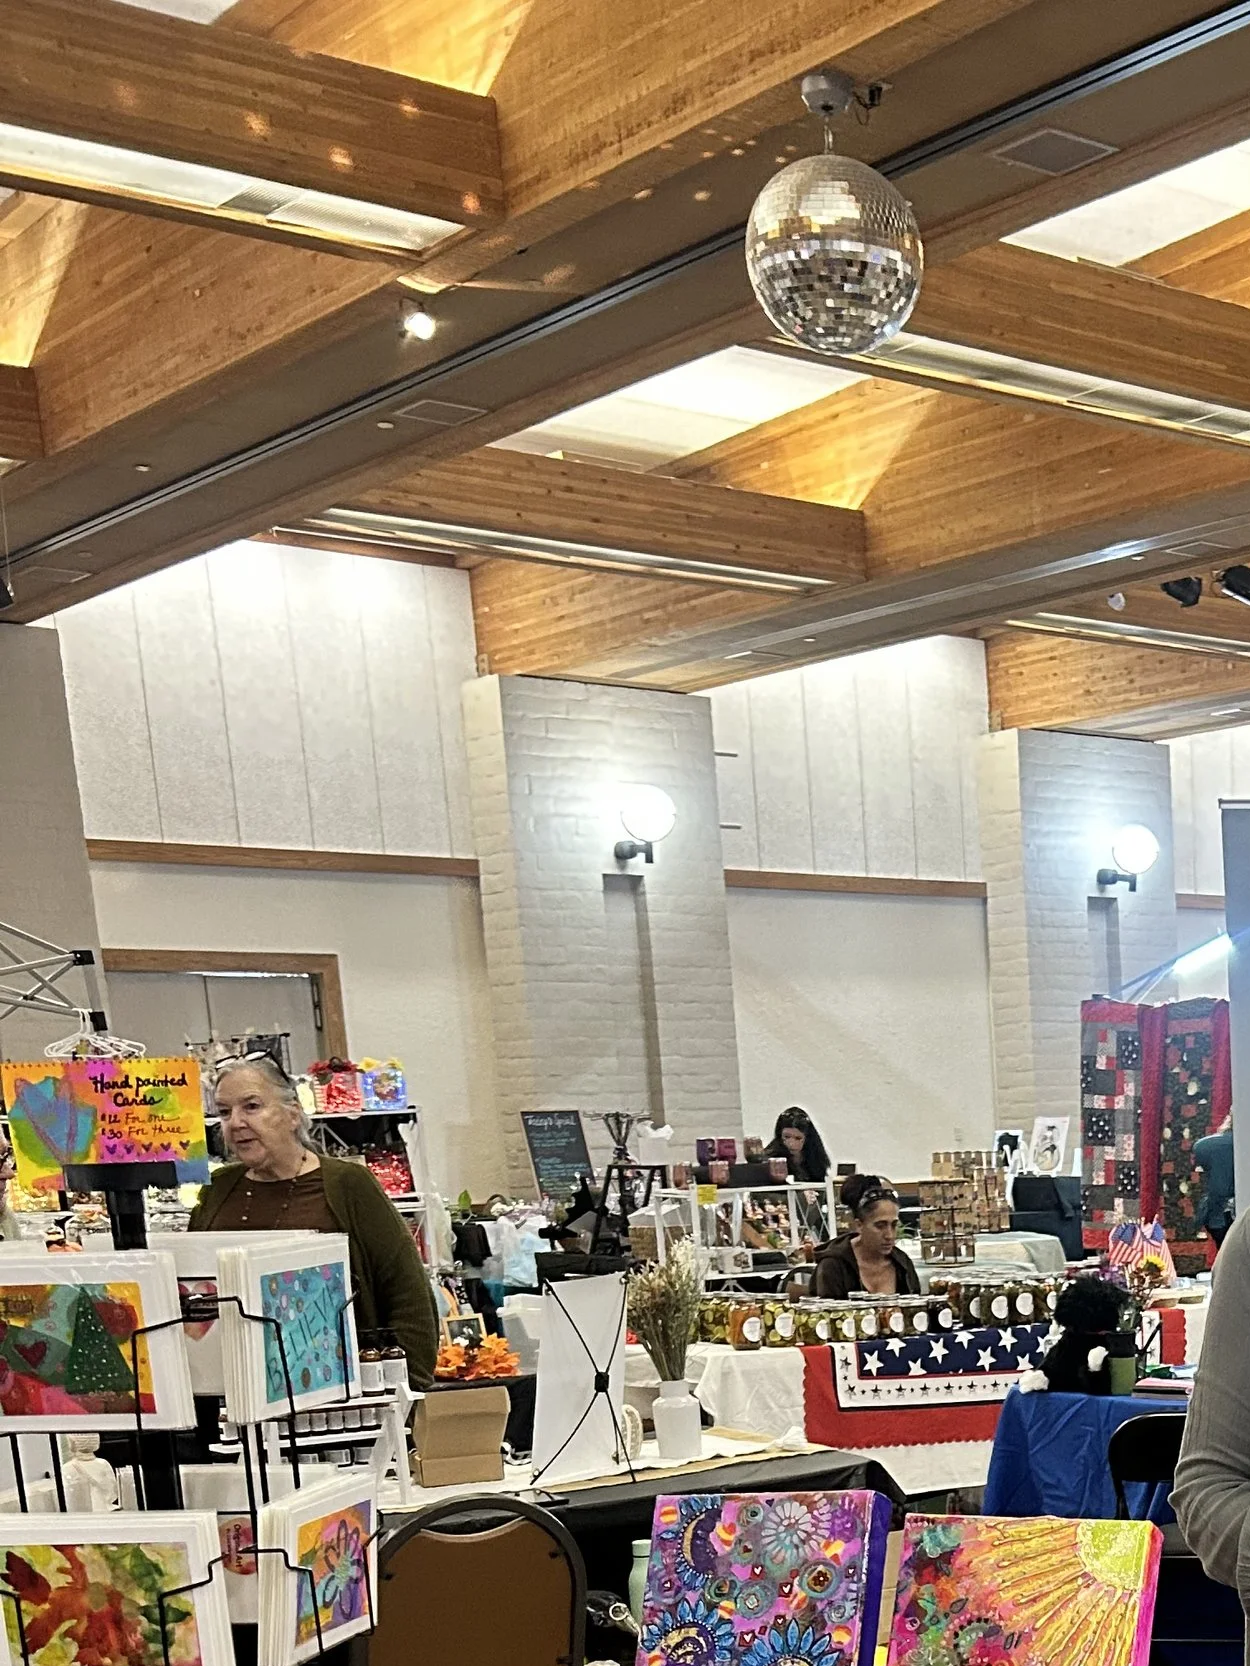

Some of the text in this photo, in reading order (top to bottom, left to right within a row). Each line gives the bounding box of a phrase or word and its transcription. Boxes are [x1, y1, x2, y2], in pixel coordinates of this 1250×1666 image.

[89, 1073, 188, 1097] Hand painted
[113, 1095, 162, 1107] Cards
[101, 1112, 120, 1123] $12
[125, 1112, 145, 1123] For
[101, 1125, 189, 1140] $30 For three
